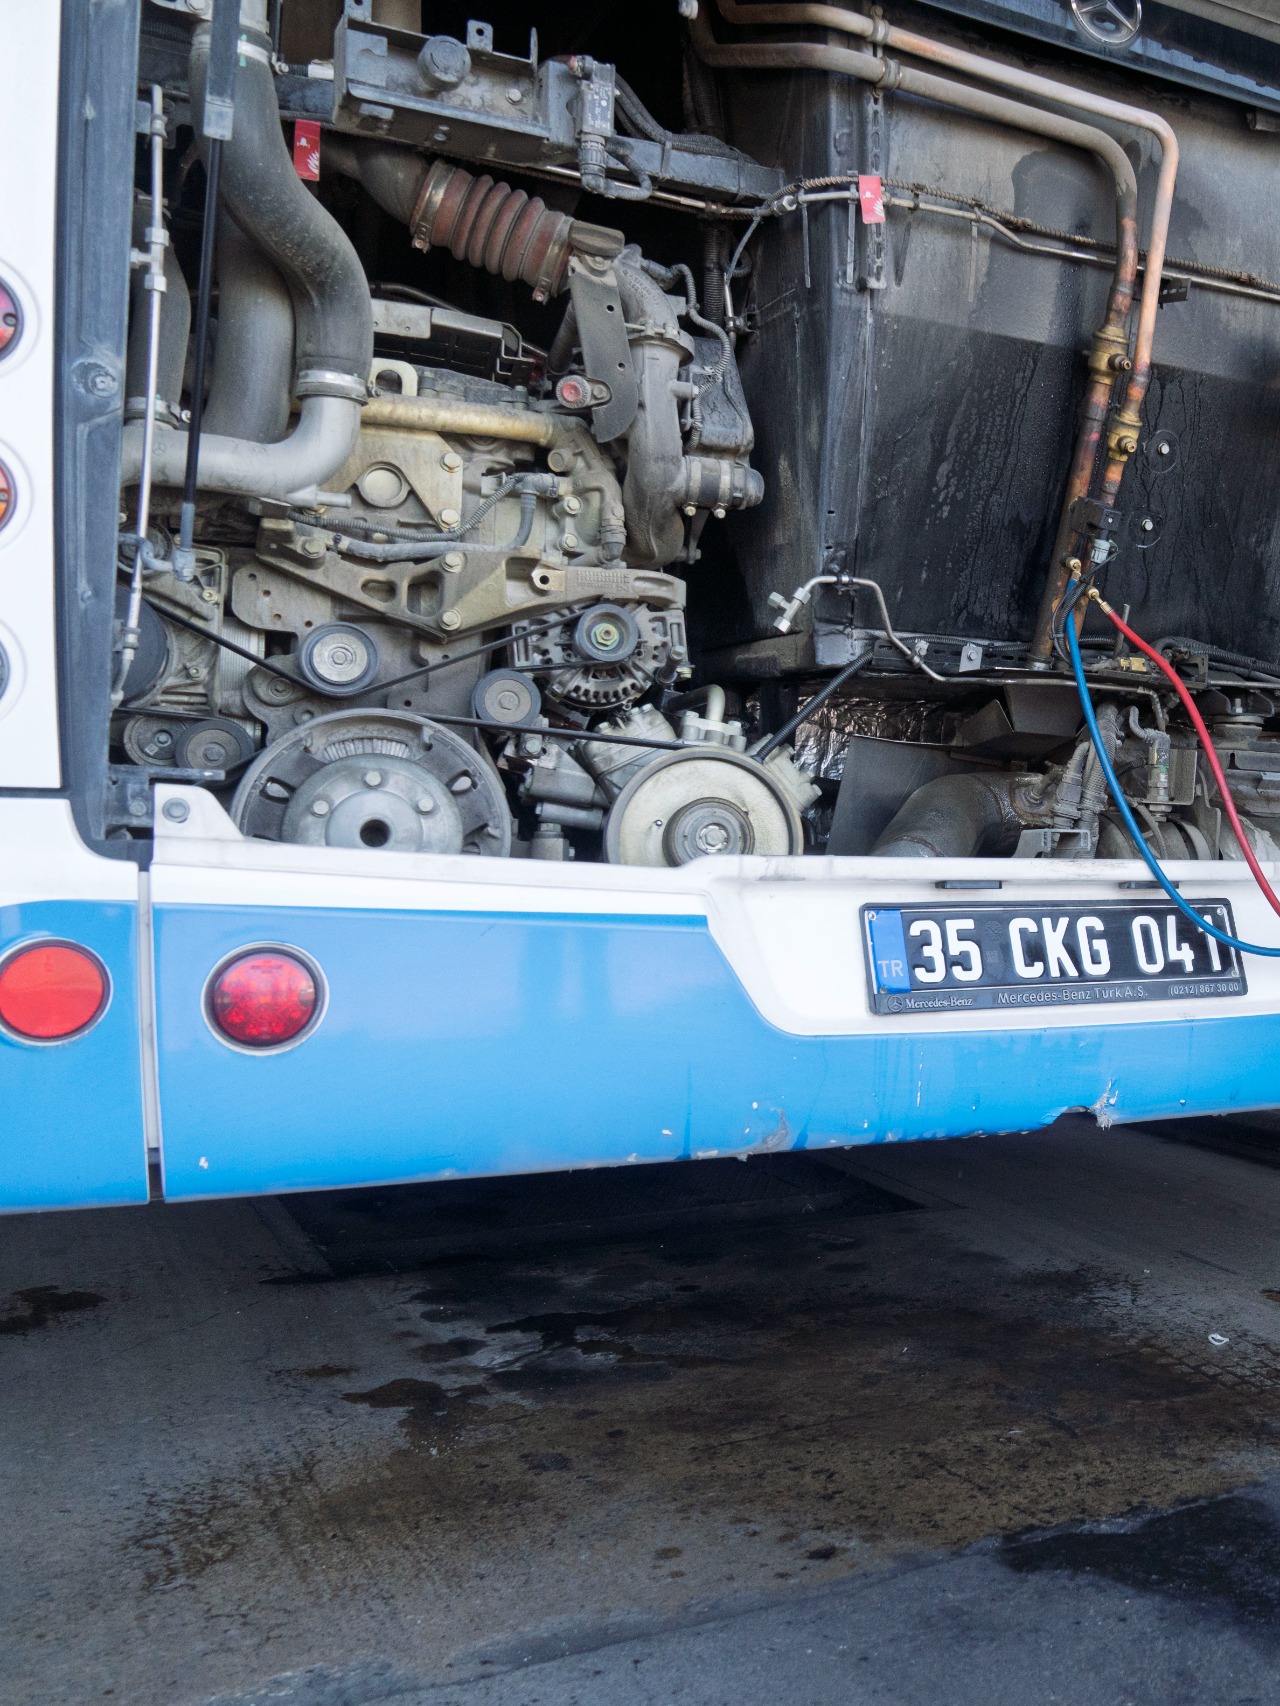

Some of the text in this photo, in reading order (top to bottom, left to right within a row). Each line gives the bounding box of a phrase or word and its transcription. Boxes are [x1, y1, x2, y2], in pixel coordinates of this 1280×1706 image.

[877, 914, 1222, 984] TR 35 CKG 041
[998, 988, 1091, 1004] Mercedes-Benz
[1093, 987, 1122, 1000] Türk
[1170, 982, 1239, 996] (0212) 867 30 00
[905, 996, 973, 1009] Mercedes-Benz
